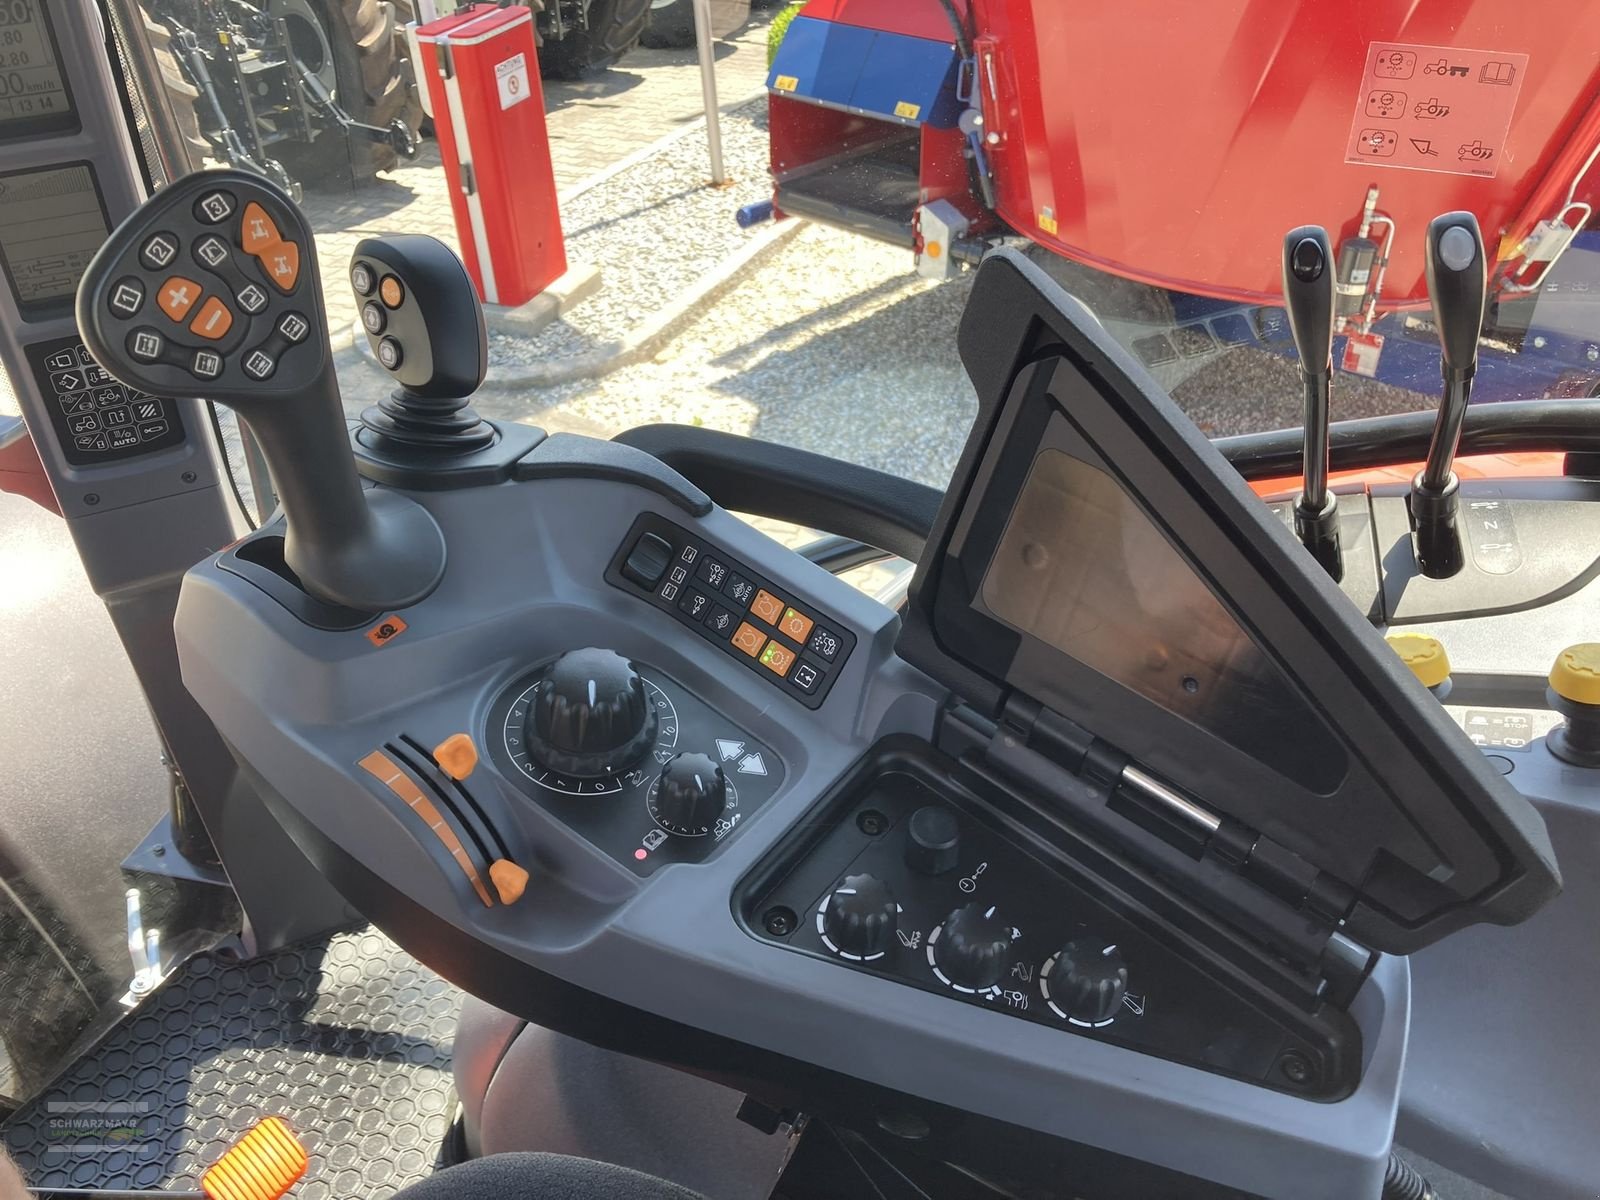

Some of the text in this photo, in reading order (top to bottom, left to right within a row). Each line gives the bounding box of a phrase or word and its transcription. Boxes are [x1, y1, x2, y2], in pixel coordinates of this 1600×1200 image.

[210, 201, 223, 215] 3
[152, 245, 167, 258] 2
[121, 294, 135, 302] 1
[113, 437, 137, 447] AUTO
[714, 569, 725, 585] AUTO
[741, 585, 753, 602] AUTO
[657, 701, 668, 709] 9
[514, 709, 523, 717] 4
[662, 726, 676, 737] 10
[509, 737, 520, 746] 3
[524, 762, 536, 772] 2
[557, 779, 566, 787] 1
[594, 783, 605, 791] 0
[726, 801, 736, 810] 10
